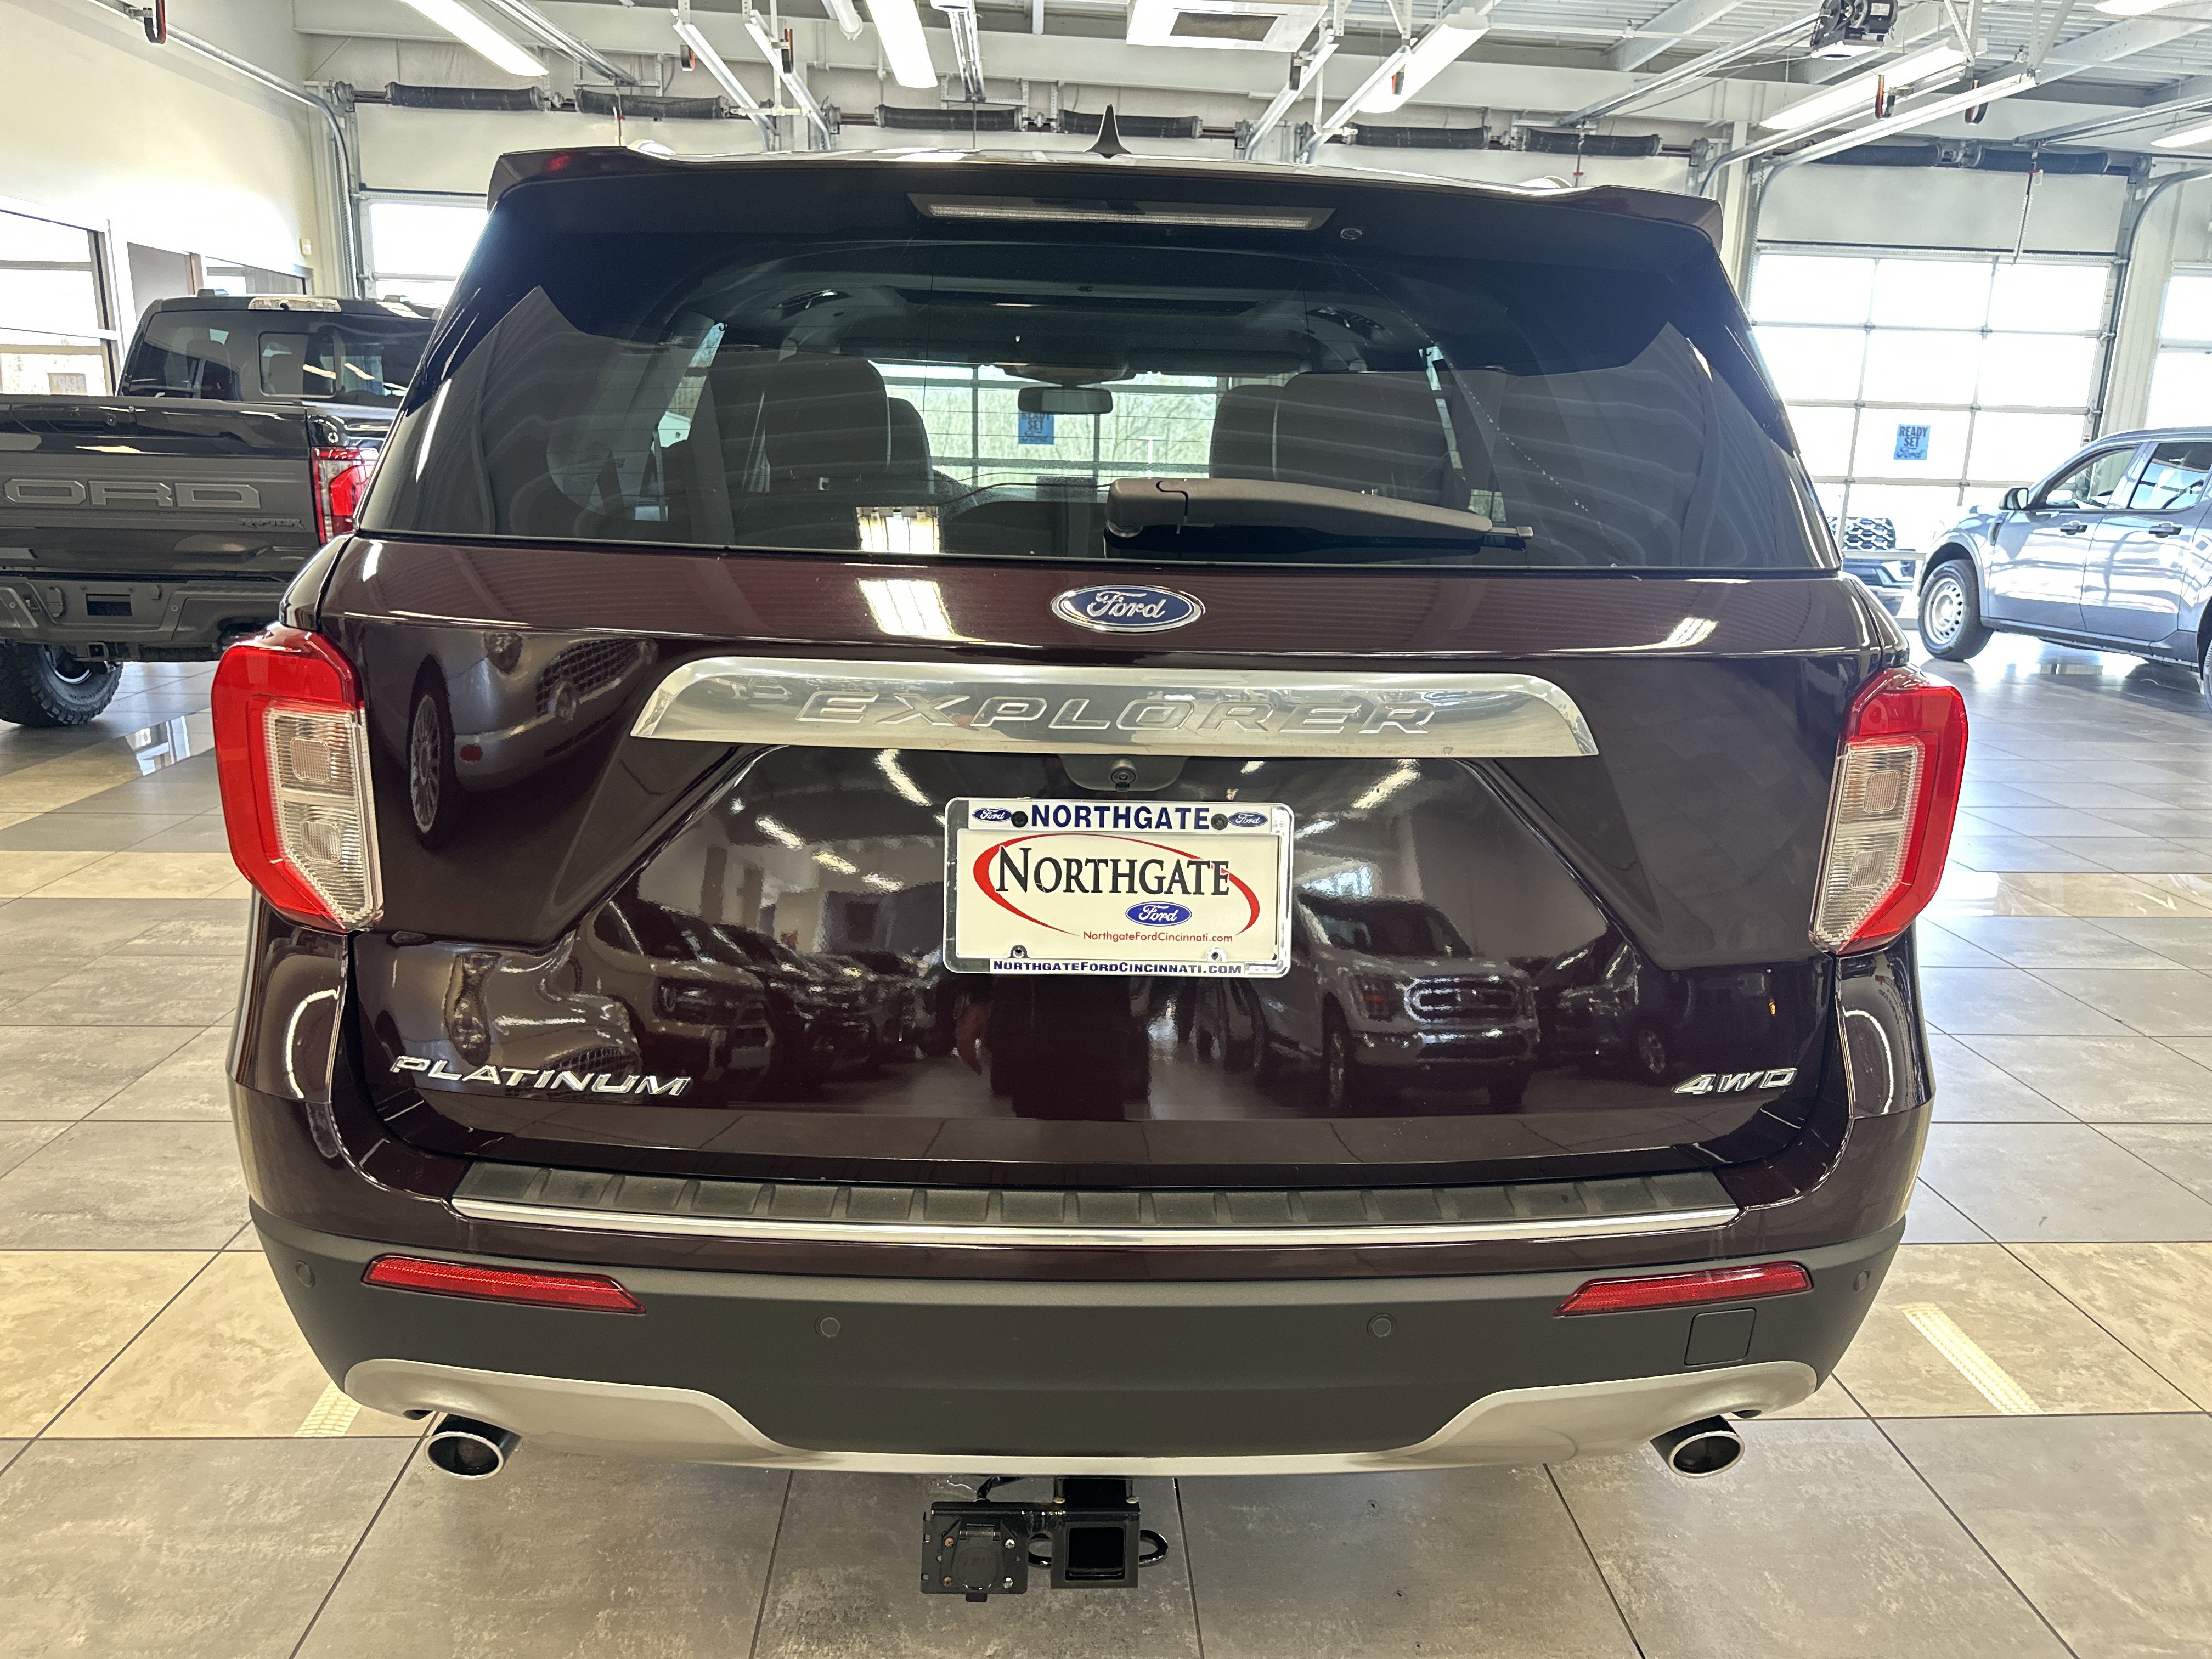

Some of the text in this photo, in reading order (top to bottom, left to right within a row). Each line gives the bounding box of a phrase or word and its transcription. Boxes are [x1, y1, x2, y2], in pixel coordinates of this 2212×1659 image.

[1028, 420, 1043, 431] SET
[1899, 426, 1928, 437] READY
[1904, 437, 1920, 447] SET
[3, 478, 261, 509] ORD
[238, 517, 306, 530] RAPTOR
[1087, 591, 1167, 618] Ford
[796, 691, 1436, 734] EXPLORER
[980, 804, 1260, 830] Ford NORTHGATE Ford
[995, 845, 1229, 895] NORTHGATE
[1138, 905, 1179, 922] Ford
[1083, 930, 1233, 943] NorthgateFordCincinnati.com
[389, 1055, 691, 1096] PLATINUM
[1672, 1067, 1798, 1094] 4WD
